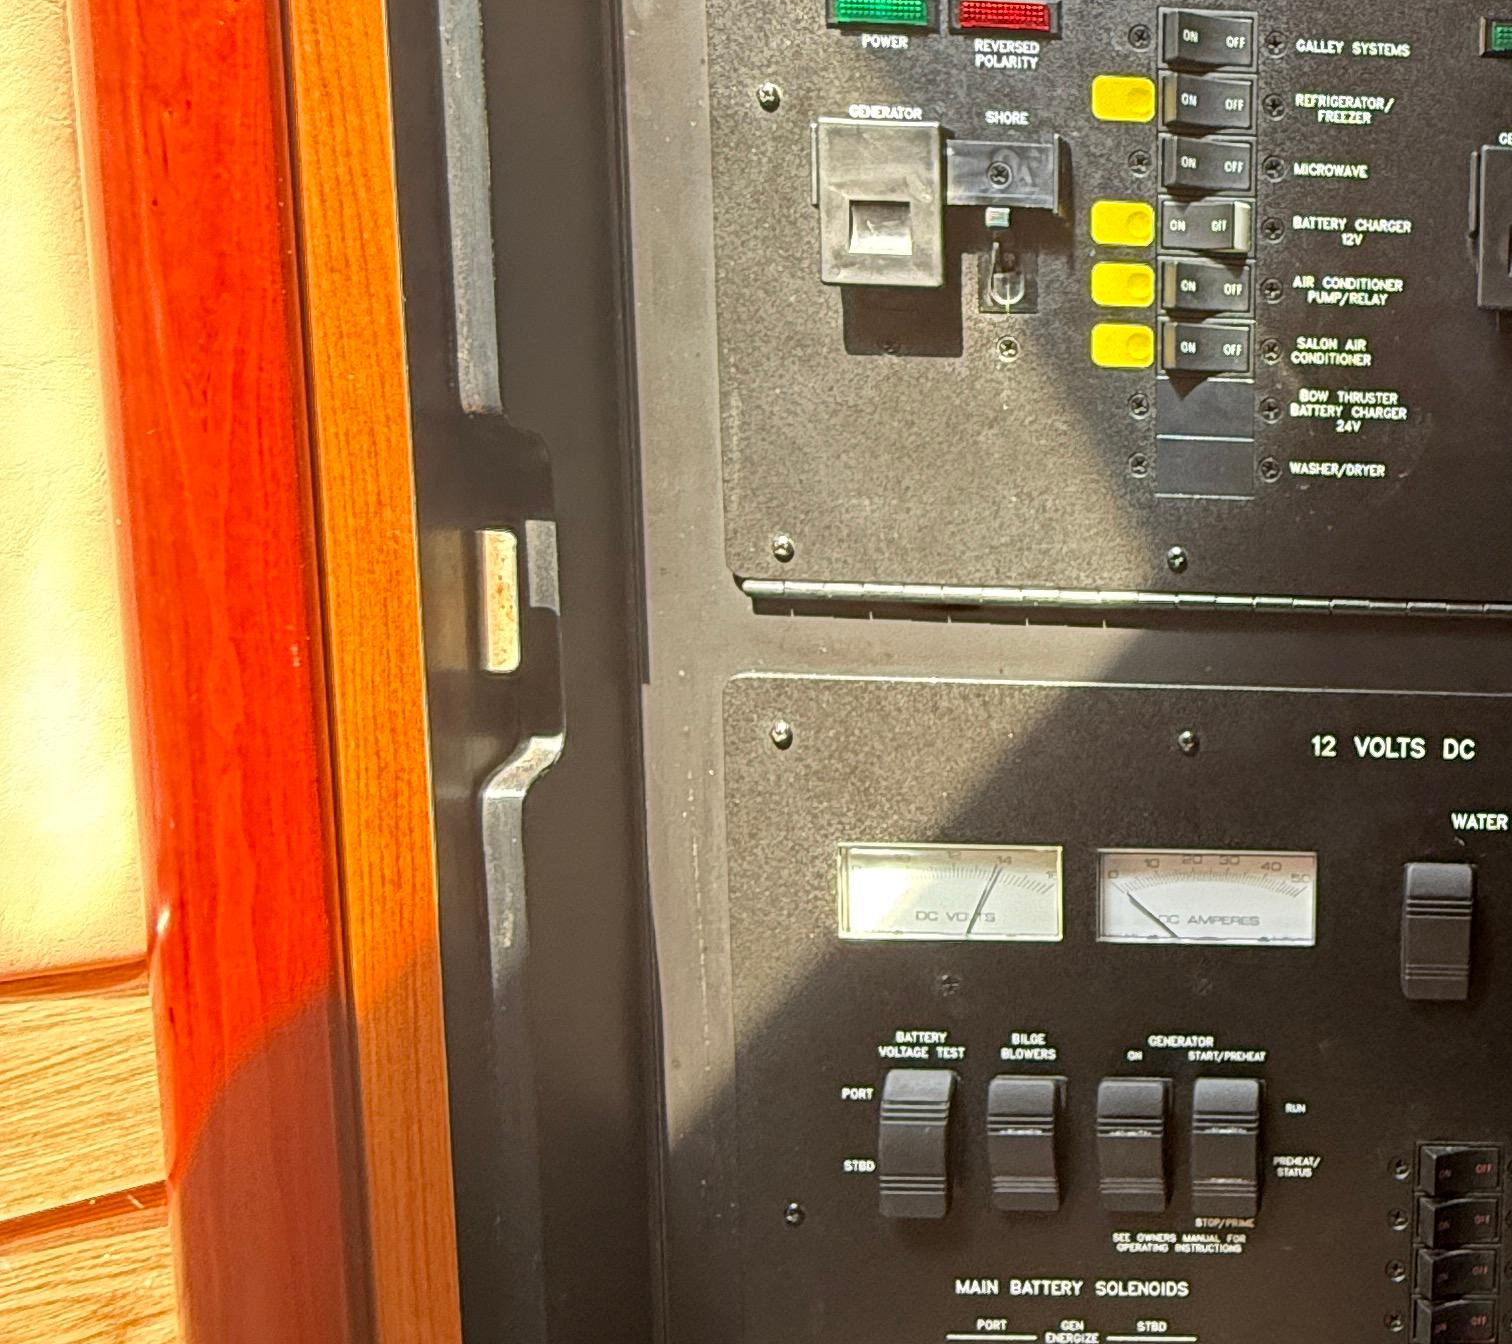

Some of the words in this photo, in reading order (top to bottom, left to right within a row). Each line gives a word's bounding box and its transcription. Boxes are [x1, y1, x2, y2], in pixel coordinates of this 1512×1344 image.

[859, 34, 908, 49] POWER
[1183, 29, 1198, 42] ON
[1226, 36, 1245, 48] OFF
[974, 38, 1040, 54] REVERSED
[1296, 39, 1344, 53] GALLEY
[1352, 41, 1410, 57] SYSTEMS
[975, 54, 1038, 69] POLARITY
[1295, 94, 1394, 115] REFRIGERATOR/
[847, 104, 922, 120] GENERATOR
[985, 111, 1028, 125] SHORE
[1318, 110, 1371, 124] FREEZER
[1294, 163, 1368, 178] MICROWAVE
[1293, 216, 1346, 230] BATTERY
[1355, 219, 1411, 233] CHARGER
[1342, 233, 1363, 245] 12V
[1293, 276, 1314, 288] AIR
[1322, 276, 1403, 291] CONDITIONER
[1307, 290, 1388, 306] PUMP/RELAY
[1297, 336, 1337, 350] SALON
[1345, 339, 1366, 351] AIR
[1291, 351, 1371, 366] CONDITIONER
[1299, 388, 1329, 402] BOW
[1337, 391, 1398, 404] THRUSTER
[1290, 403, 1343, 417] BATTERY
[1351, 406, 1407, 419] CHARGER
[1336, 419, 1361, 432] 24V
[1289, 462, 1385, 477] WASHER/DRYER
[1312, 736, 1336, 756] 12
[1354, 736, 1425, 758] VOLTS
[1443, 738, 1475, 759] DC
[1451, 813, 1508, 830] WATER
[896, 1031, 947, 1043] BATTERY
[1012, 1033, 1046, 1045] BILGE
[1148, 1035, 1214, 1047] GENERATOR
[878, 1046, 928, 1058] VOLTAGE
[936, 1047, 965, 1058] TEST
[1001, 1048, 1056, 1060] BLOWERS
[1188, 1051, 1266, 1062] START/PREHEAT
[842, 1088, 873, 1099] PORT
[1286, 1103, 1306, 1113] RUN
[844, 1160, 875, 1171] STBD
[1277, 1167, 1312, 1177] STATUS
[1195, 1218, 1254, 1228] STOP/PRIME
[1113, 1233, 1130, 1242] SEE
[1137, 1233, 1176, 1243] OWNERS
[1182, 1234, 1220, 1245] MANUAL
[1227, 1234, 1246, 1243] FOR
[1116, 1243, 1168, 1252] OPERATING
[1175, 1243, 1241, 1253] INSTRUCTIONS
[956, 1280, 998, 1294] MAIN
[1010, 1280, 1083, 1295] BATTERY
[1095, 1281, 1189, 1296] SOLENOIDS
[977, 1319, 1007, 1330] PORT
[1061, 1320, 1084, 1331] GEN
[1137, 1321, 1167, 1332] STBD
[1045, 1332, 1099, 1344] ENERGIZE
